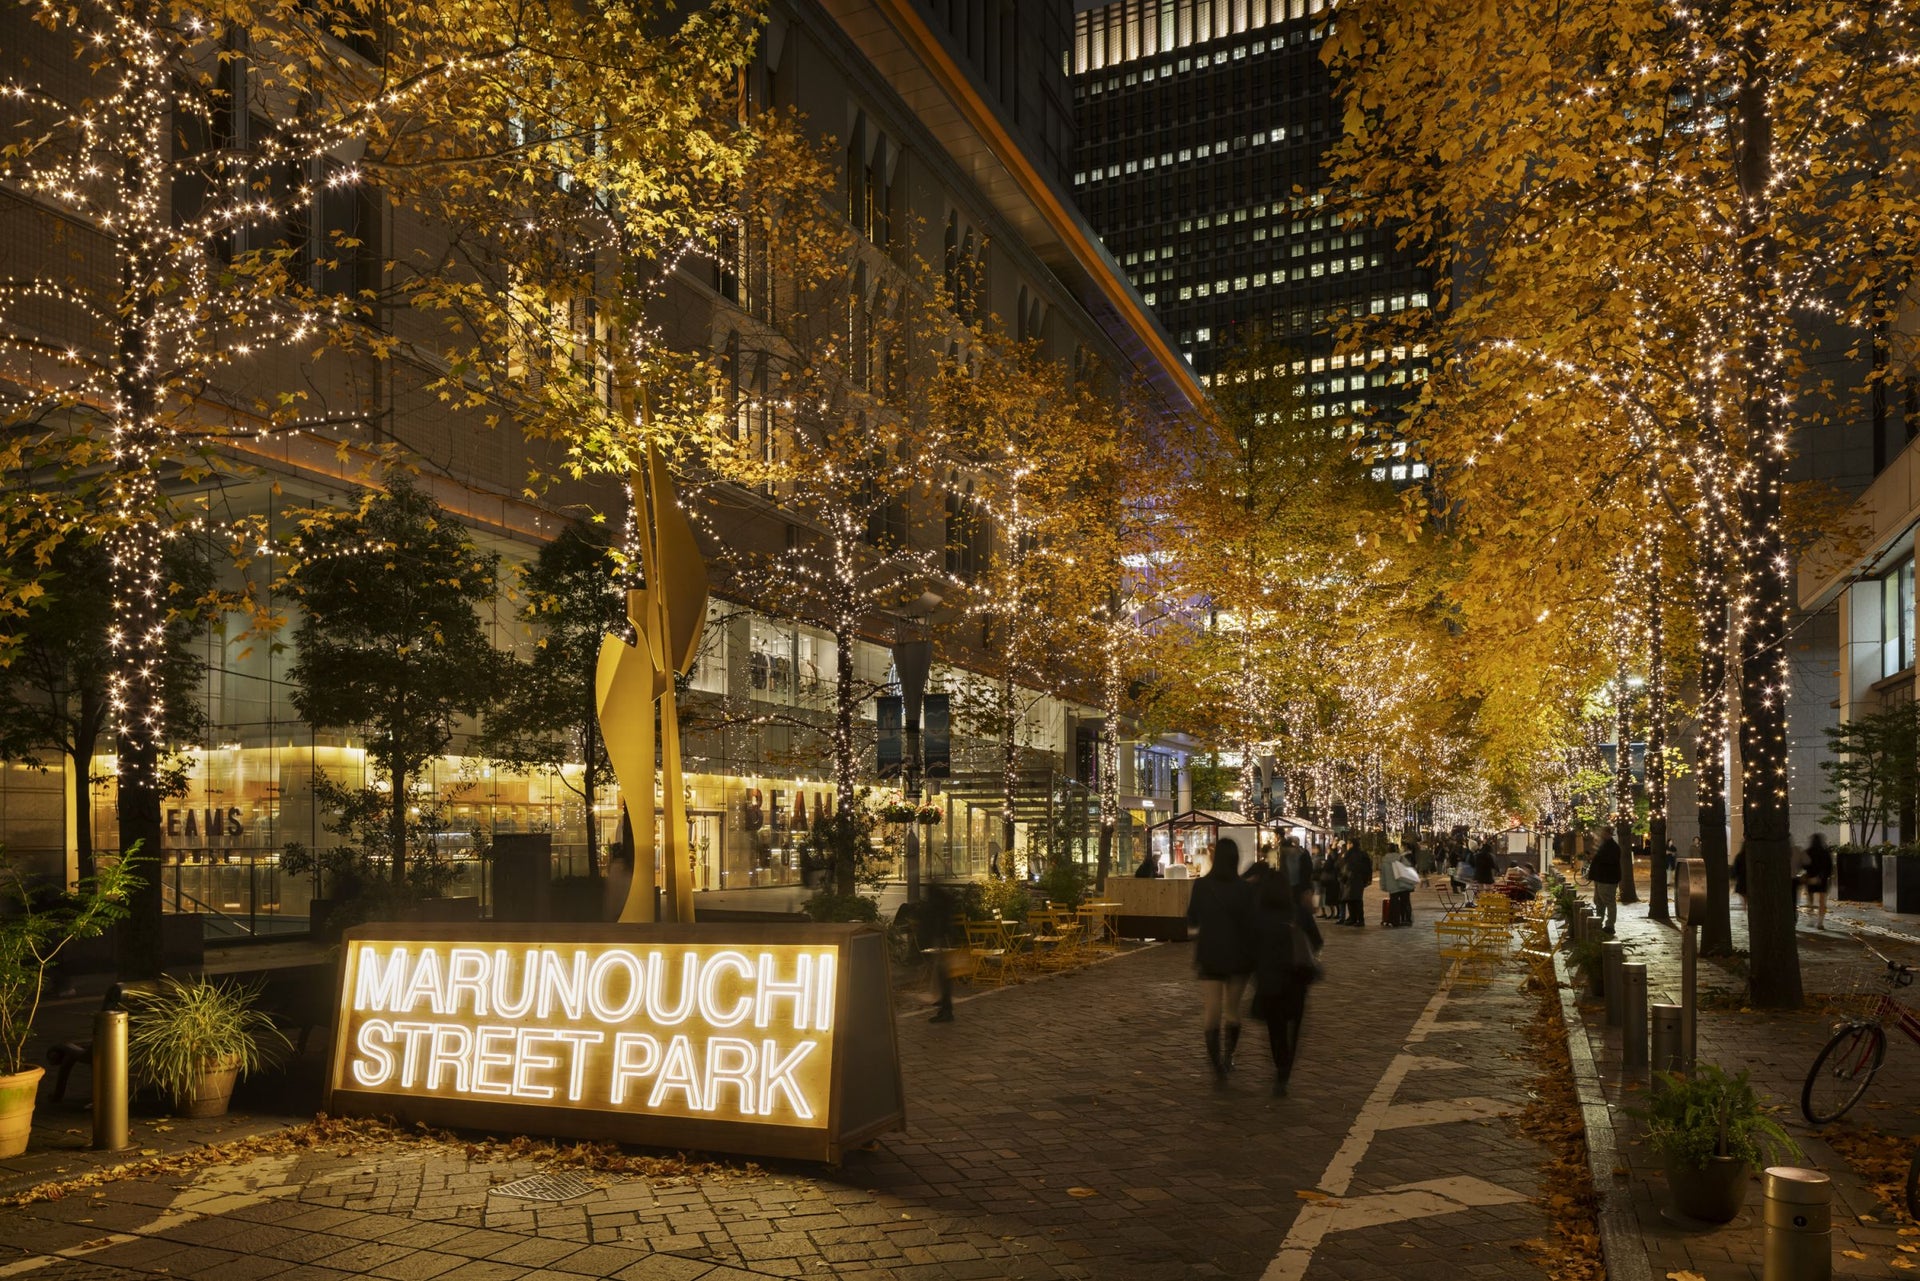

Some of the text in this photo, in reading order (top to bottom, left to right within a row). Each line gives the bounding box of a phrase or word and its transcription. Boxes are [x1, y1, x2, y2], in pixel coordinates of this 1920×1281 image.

[160, 807, 244, 836] EAMS
[745, 788, 834, 831] BEAM
[354, 948, 833, 1030] MARUNOUCHI
[354, 1020, 817, 1118] STREET PARK
